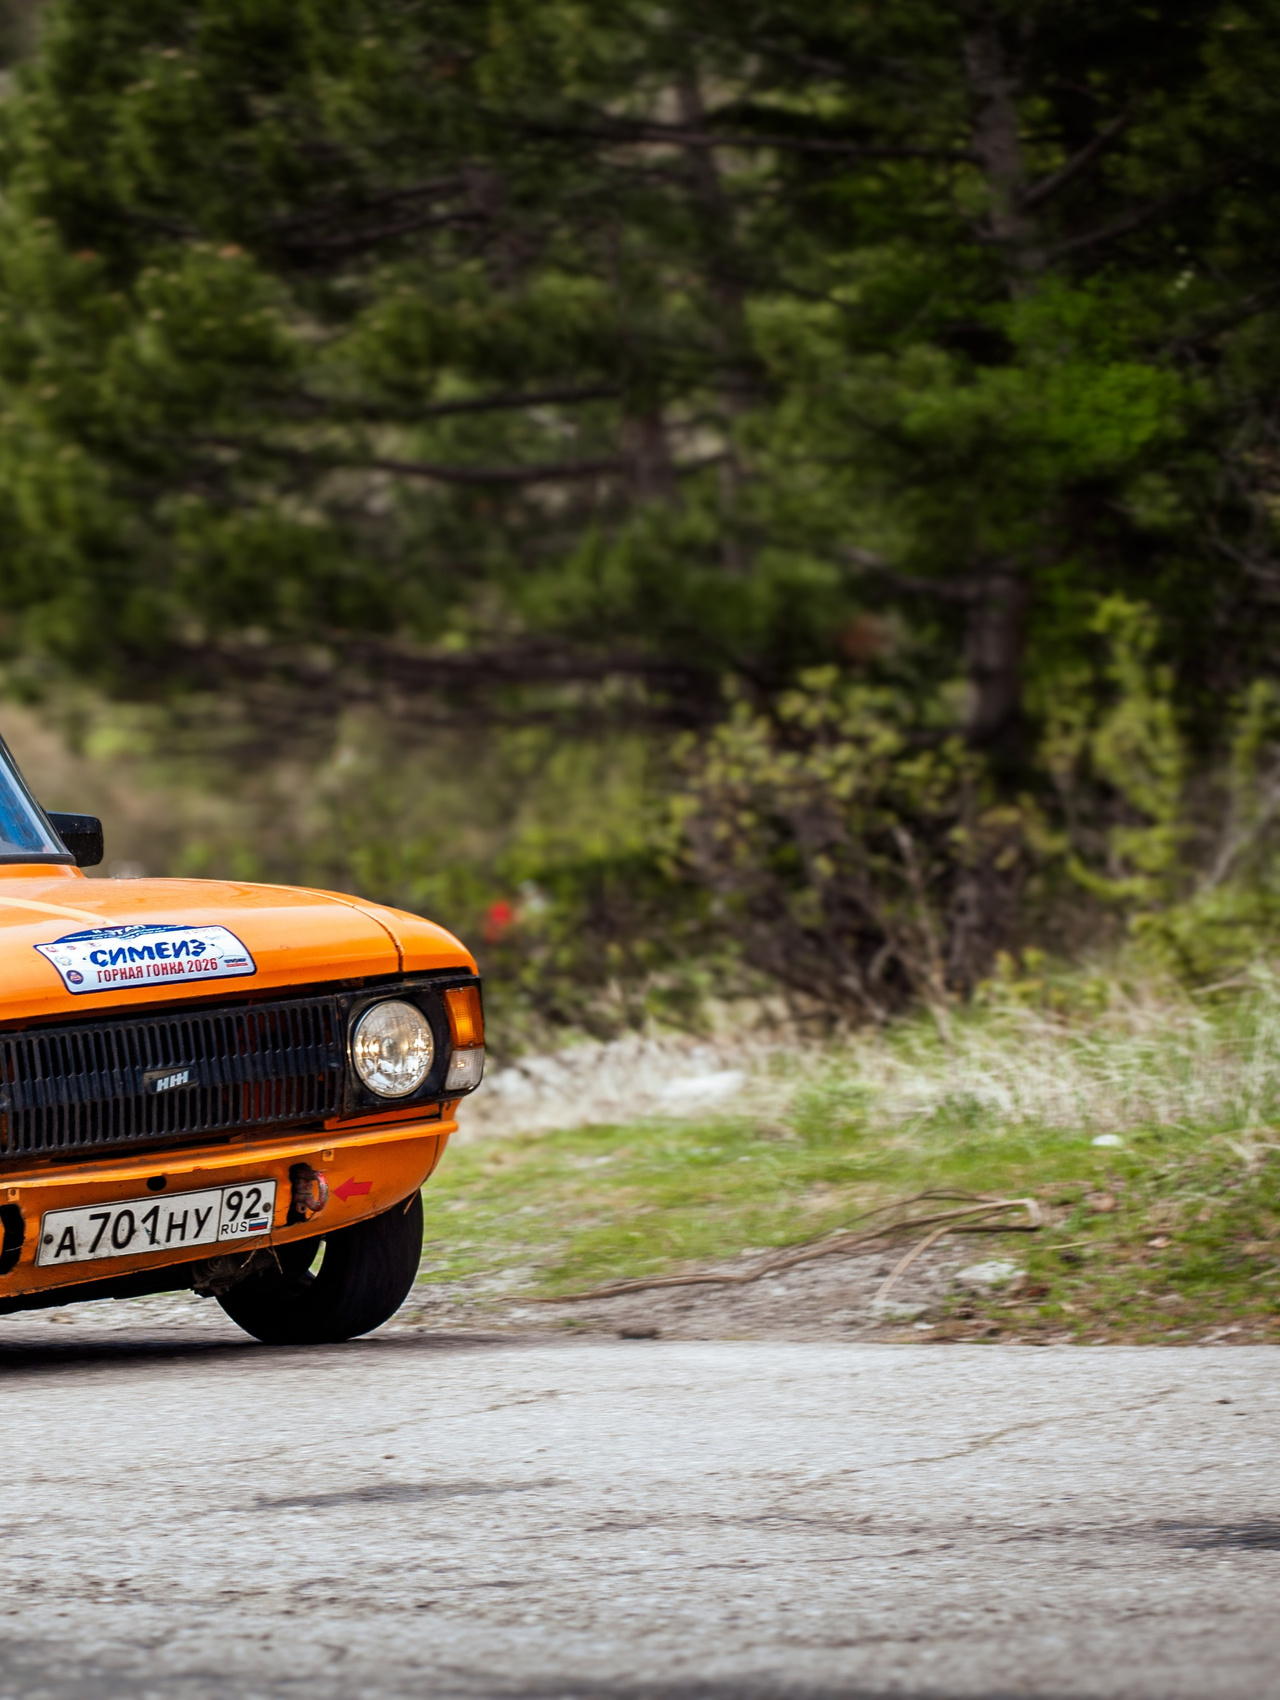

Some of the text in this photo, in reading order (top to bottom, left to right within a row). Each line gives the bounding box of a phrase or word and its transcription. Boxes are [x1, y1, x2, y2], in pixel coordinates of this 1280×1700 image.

[89, 938, 207, 967] СИМЕИЗ
[97, 965, 144, 983] ГОРНАЯ
[146, 961, 185, 977] ГОНКА
[188, 958, 218, 972] 2026
[226, 1187, 262, 1223] 92
[221, 1221, 248, 1236] RUS
